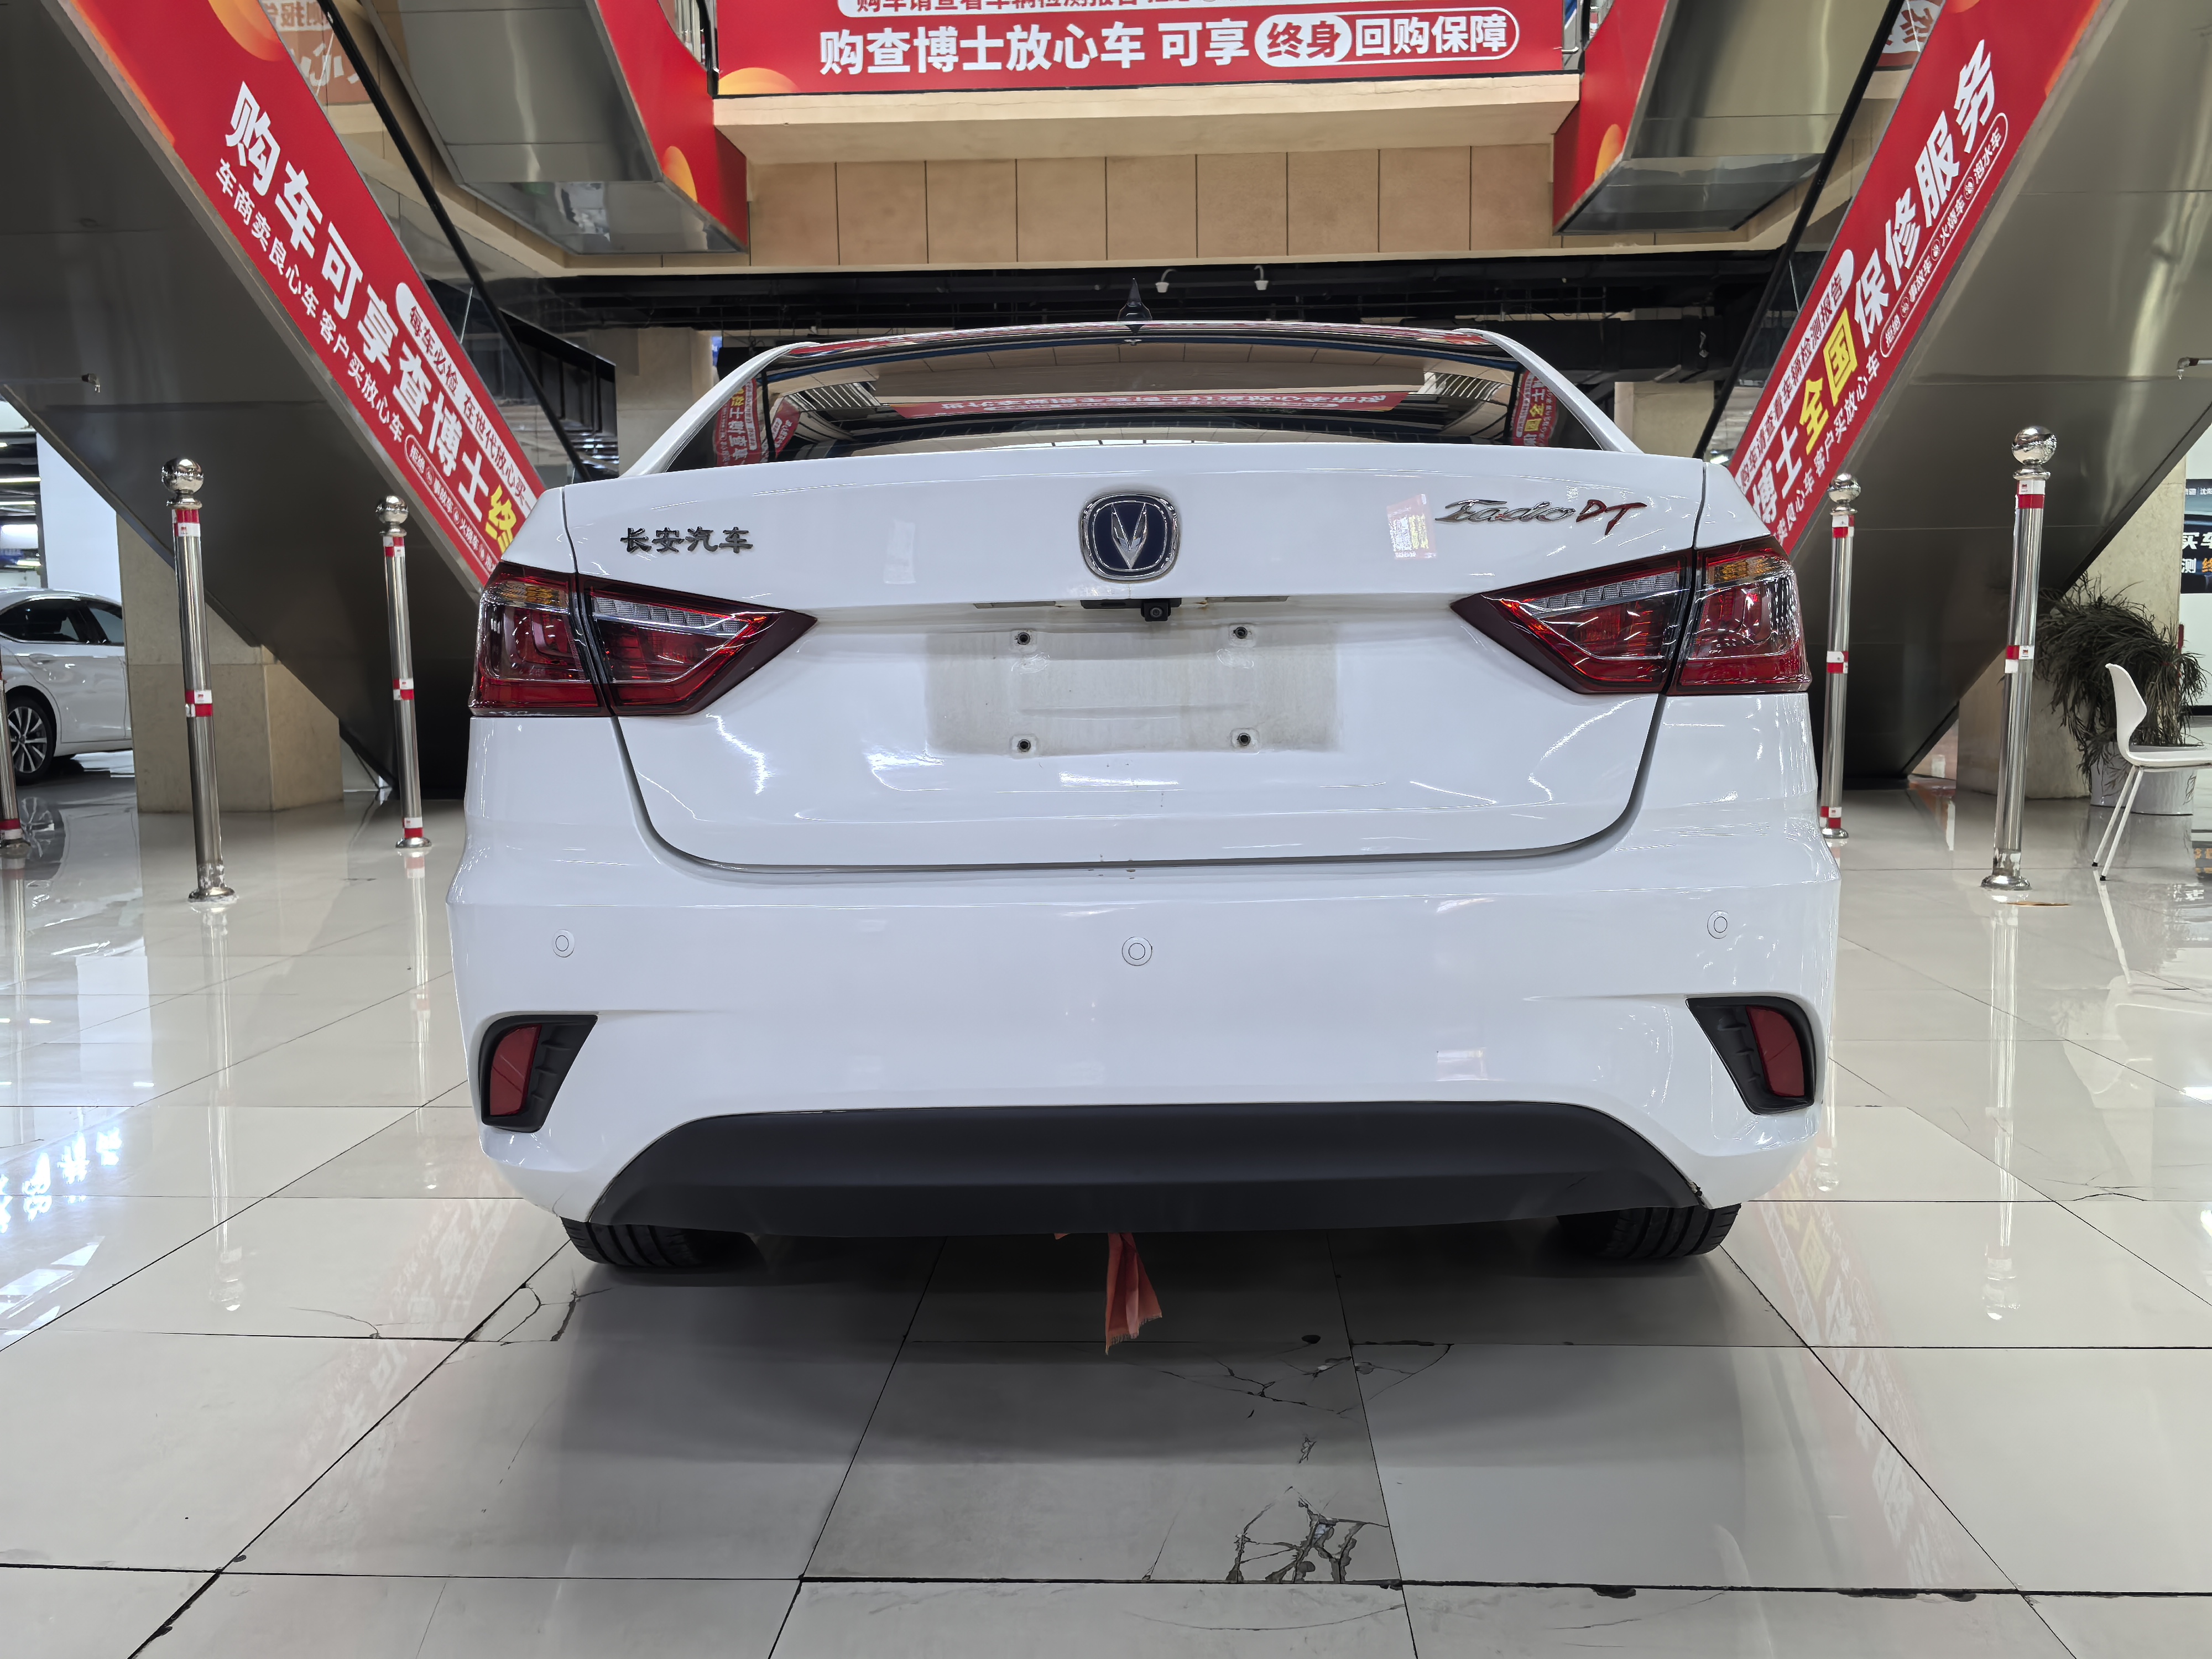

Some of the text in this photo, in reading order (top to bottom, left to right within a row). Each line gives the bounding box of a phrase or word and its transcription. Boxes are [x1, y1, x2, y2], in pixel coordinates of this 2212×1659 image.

[819, 14, 1507, 75] 购查博士放心车 可享 终身 回购保障
[216, 158, 404, 444] 车商卖良心车 客户买放心车
[1752, 39, 1995, 524] 博士全国保修服务
[1908, 255, 1932, 303] 事故车
[1939, 194, 1965, 246] 火烧车
[1973, 127, 2001, 184] 泡水车
[410, 306, 458, 396] 每车必检
[1740, 273, 1843, 491] 购车请查看车辆检测报告
[1575, 498, 1648, 536] DT
[1774, 348, 1880, 546] 卖良心车 客户买放心车
[620, 526, 753, 554] 长安汽车
